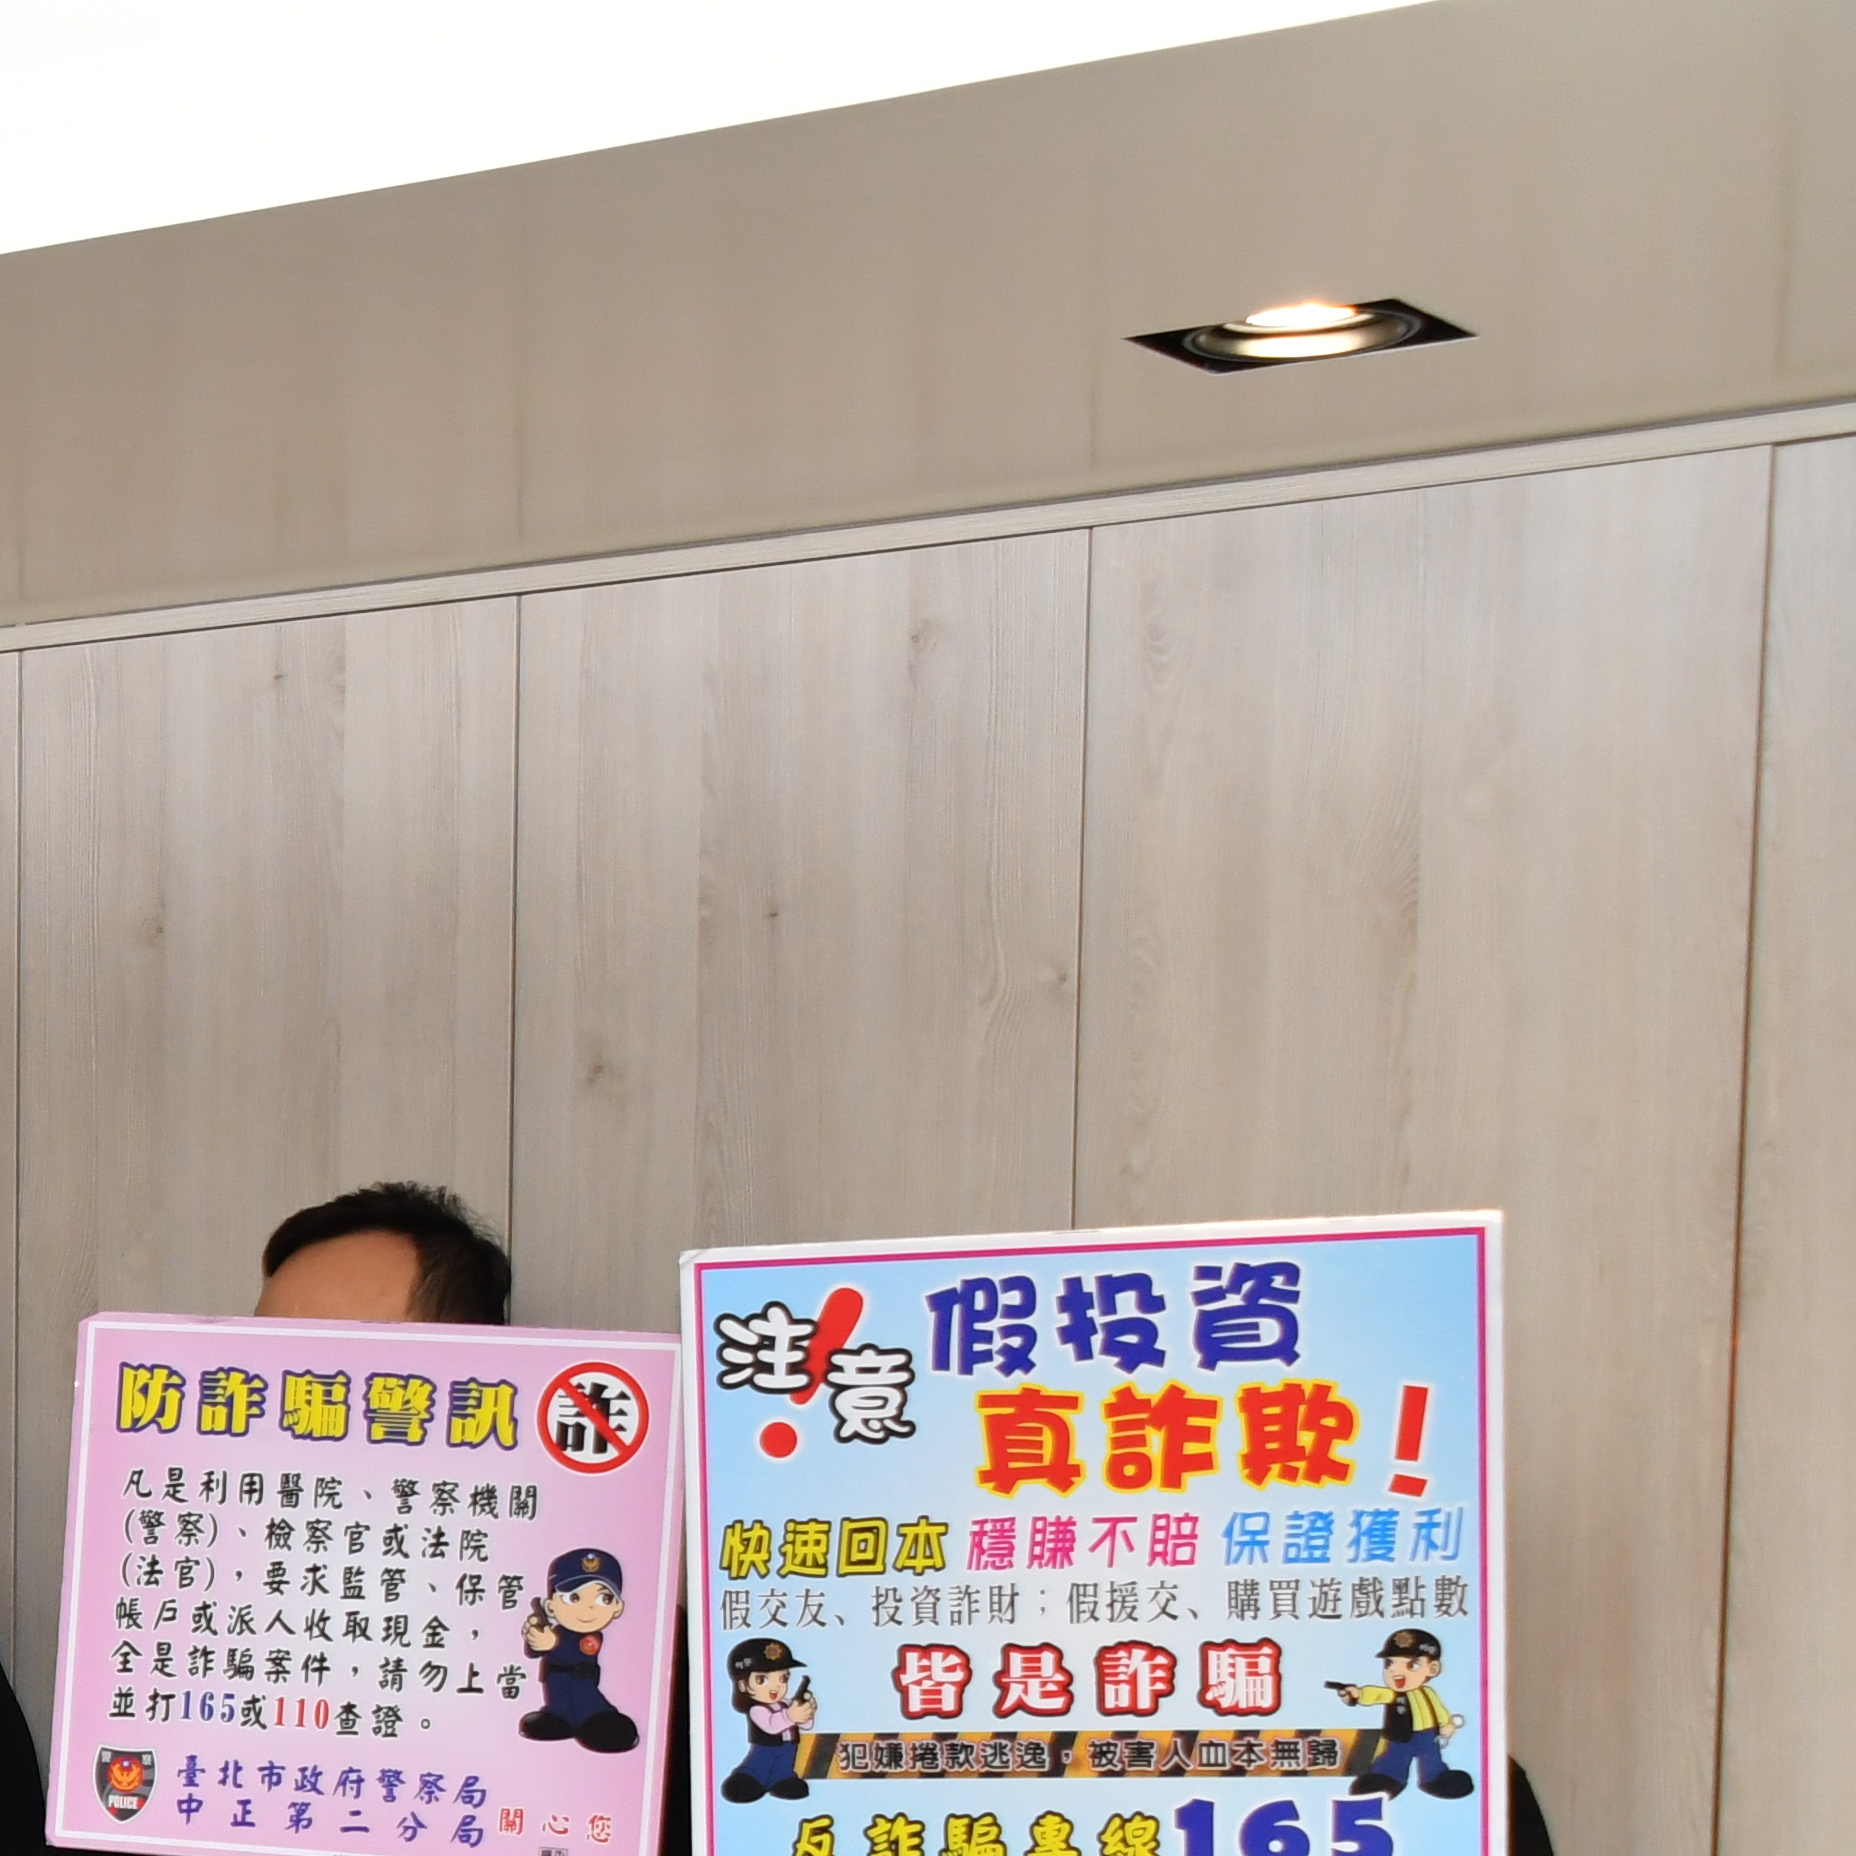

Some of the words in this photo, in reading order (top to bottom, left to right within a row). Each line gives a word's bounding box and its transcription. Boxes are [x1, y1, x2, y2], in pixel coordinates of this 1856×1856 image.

[926, 1261, 1303, 1375] 假投資
[118, 1362, 519, 1451] 防詐騙警訊
[976, 1381, 1430, 1497] 真詐欺！
[123, 1468, 538, 1521] 凡是利用醫院、警察機關
[124, 1509, 489, 1563] (警察)、檢察官或法院
[721, 1517, 949, 1578] 快速回本
[967, 1514, 1200, 1571] 穩賺不賠
[1221, 1507, 1465, 1567] 保證獲利
[121, 1552, 525, 1612] (法官)，要求監管、保管
[721, 1575, 1470, 1631] 假交友、投資詐財；假援交、購買遊戲點數
[115, 1596, 480, 1650] 帳戶或派人收取現金，
[111, 1640, 526, 1700] 全是詐騙案件，請勿上當
[893, 1639, 1282, 1720] 皆是詐騙
[110, 1689, 432, 1738] 並打165或110查證。
[178, 1754, 487, 1808] 臺北市政府警察局
[837, 1738, 1340, 1774] 犯嫌捲款逃逸，被害人血本無歸
[109, 1795, 138, 1809] POLICE
[176, 1794, 485, 1848] 中正第二分局
[500, 1808, 613, 1845] 關心您
